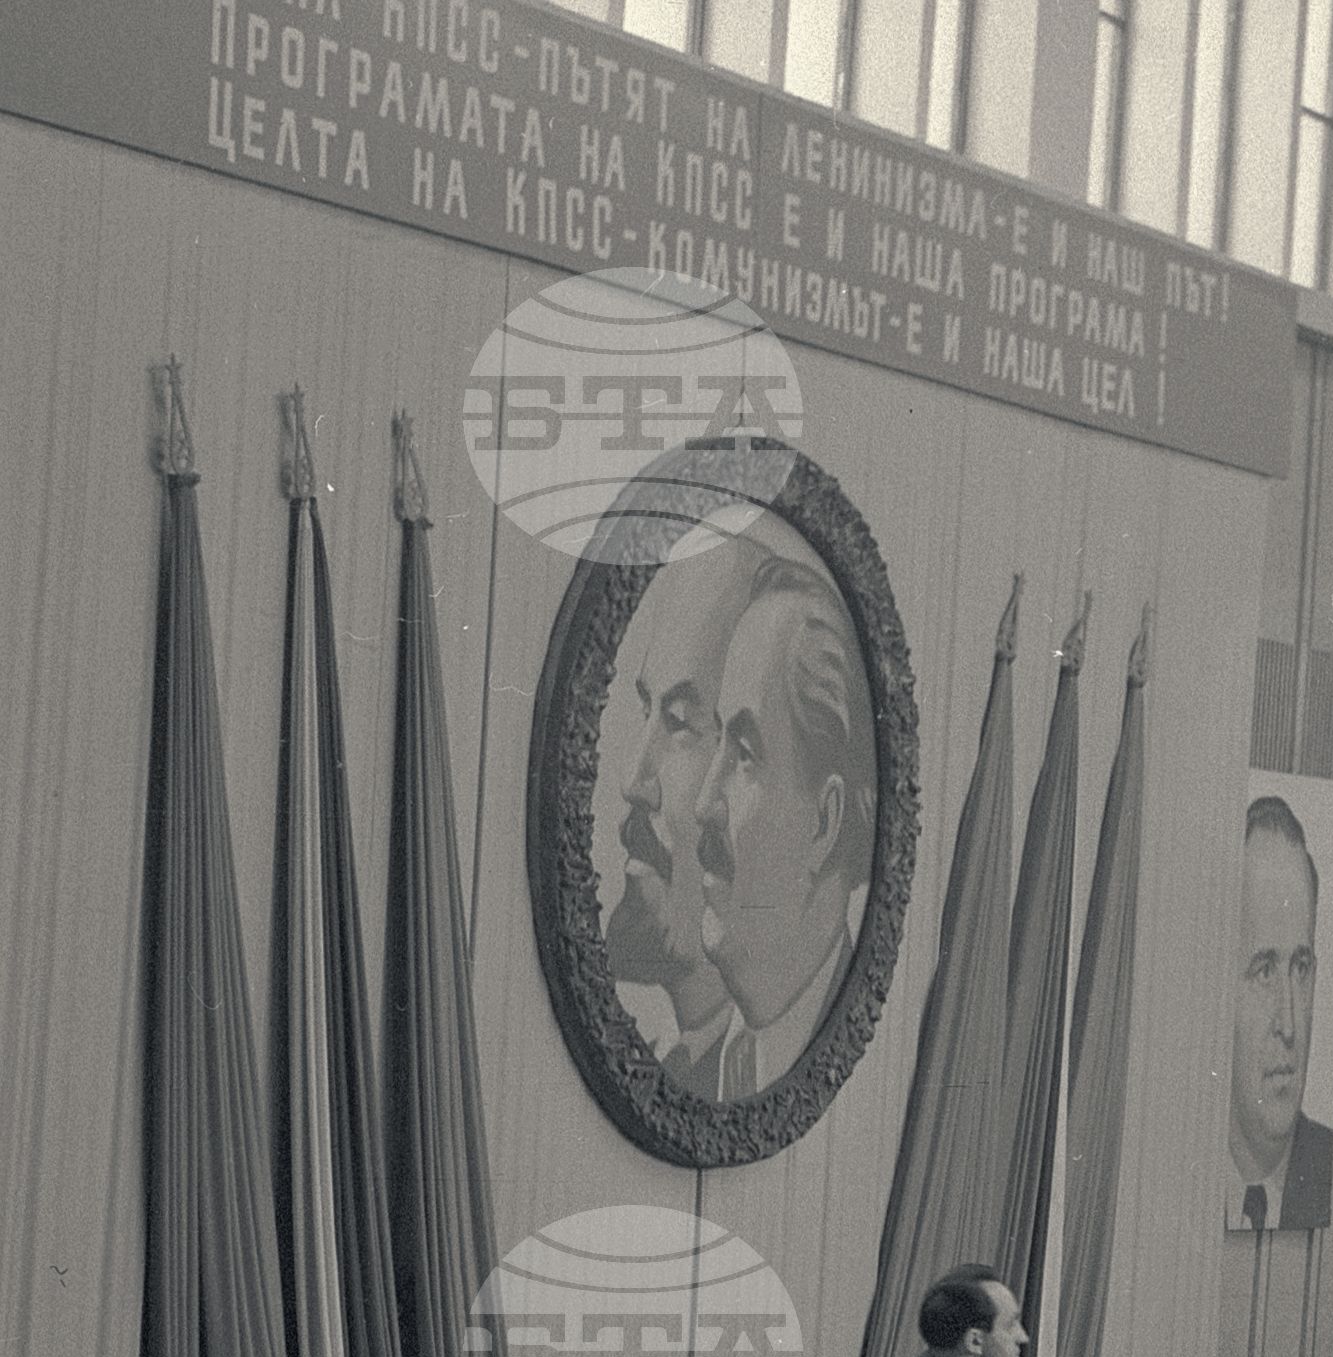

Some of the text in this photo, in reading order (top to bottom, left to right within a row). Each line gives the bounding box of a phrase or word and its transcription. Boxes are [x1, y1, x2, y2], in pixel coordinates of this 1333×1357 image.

[208, 76, 370, 191] ЦЕЛТА
[412, 147, 468, 219] НА
[943, 314, 961, 365] И
[983, 326, 1066, 398] НАША
[211, 0, 545, 168] ПРОГРАМАТА
[579, 124, 626, 191] НА
[656, 139, 753, 230] КПСС
[784, 193, 802, 248] Е
[827, 208, 845, 262] И
[872, 223, 965, 301] НАША
[706, 98, 750, 161] НА
[1052, 218, 1068, 269] И
[1087, 232, 1145, 297] НАШ
